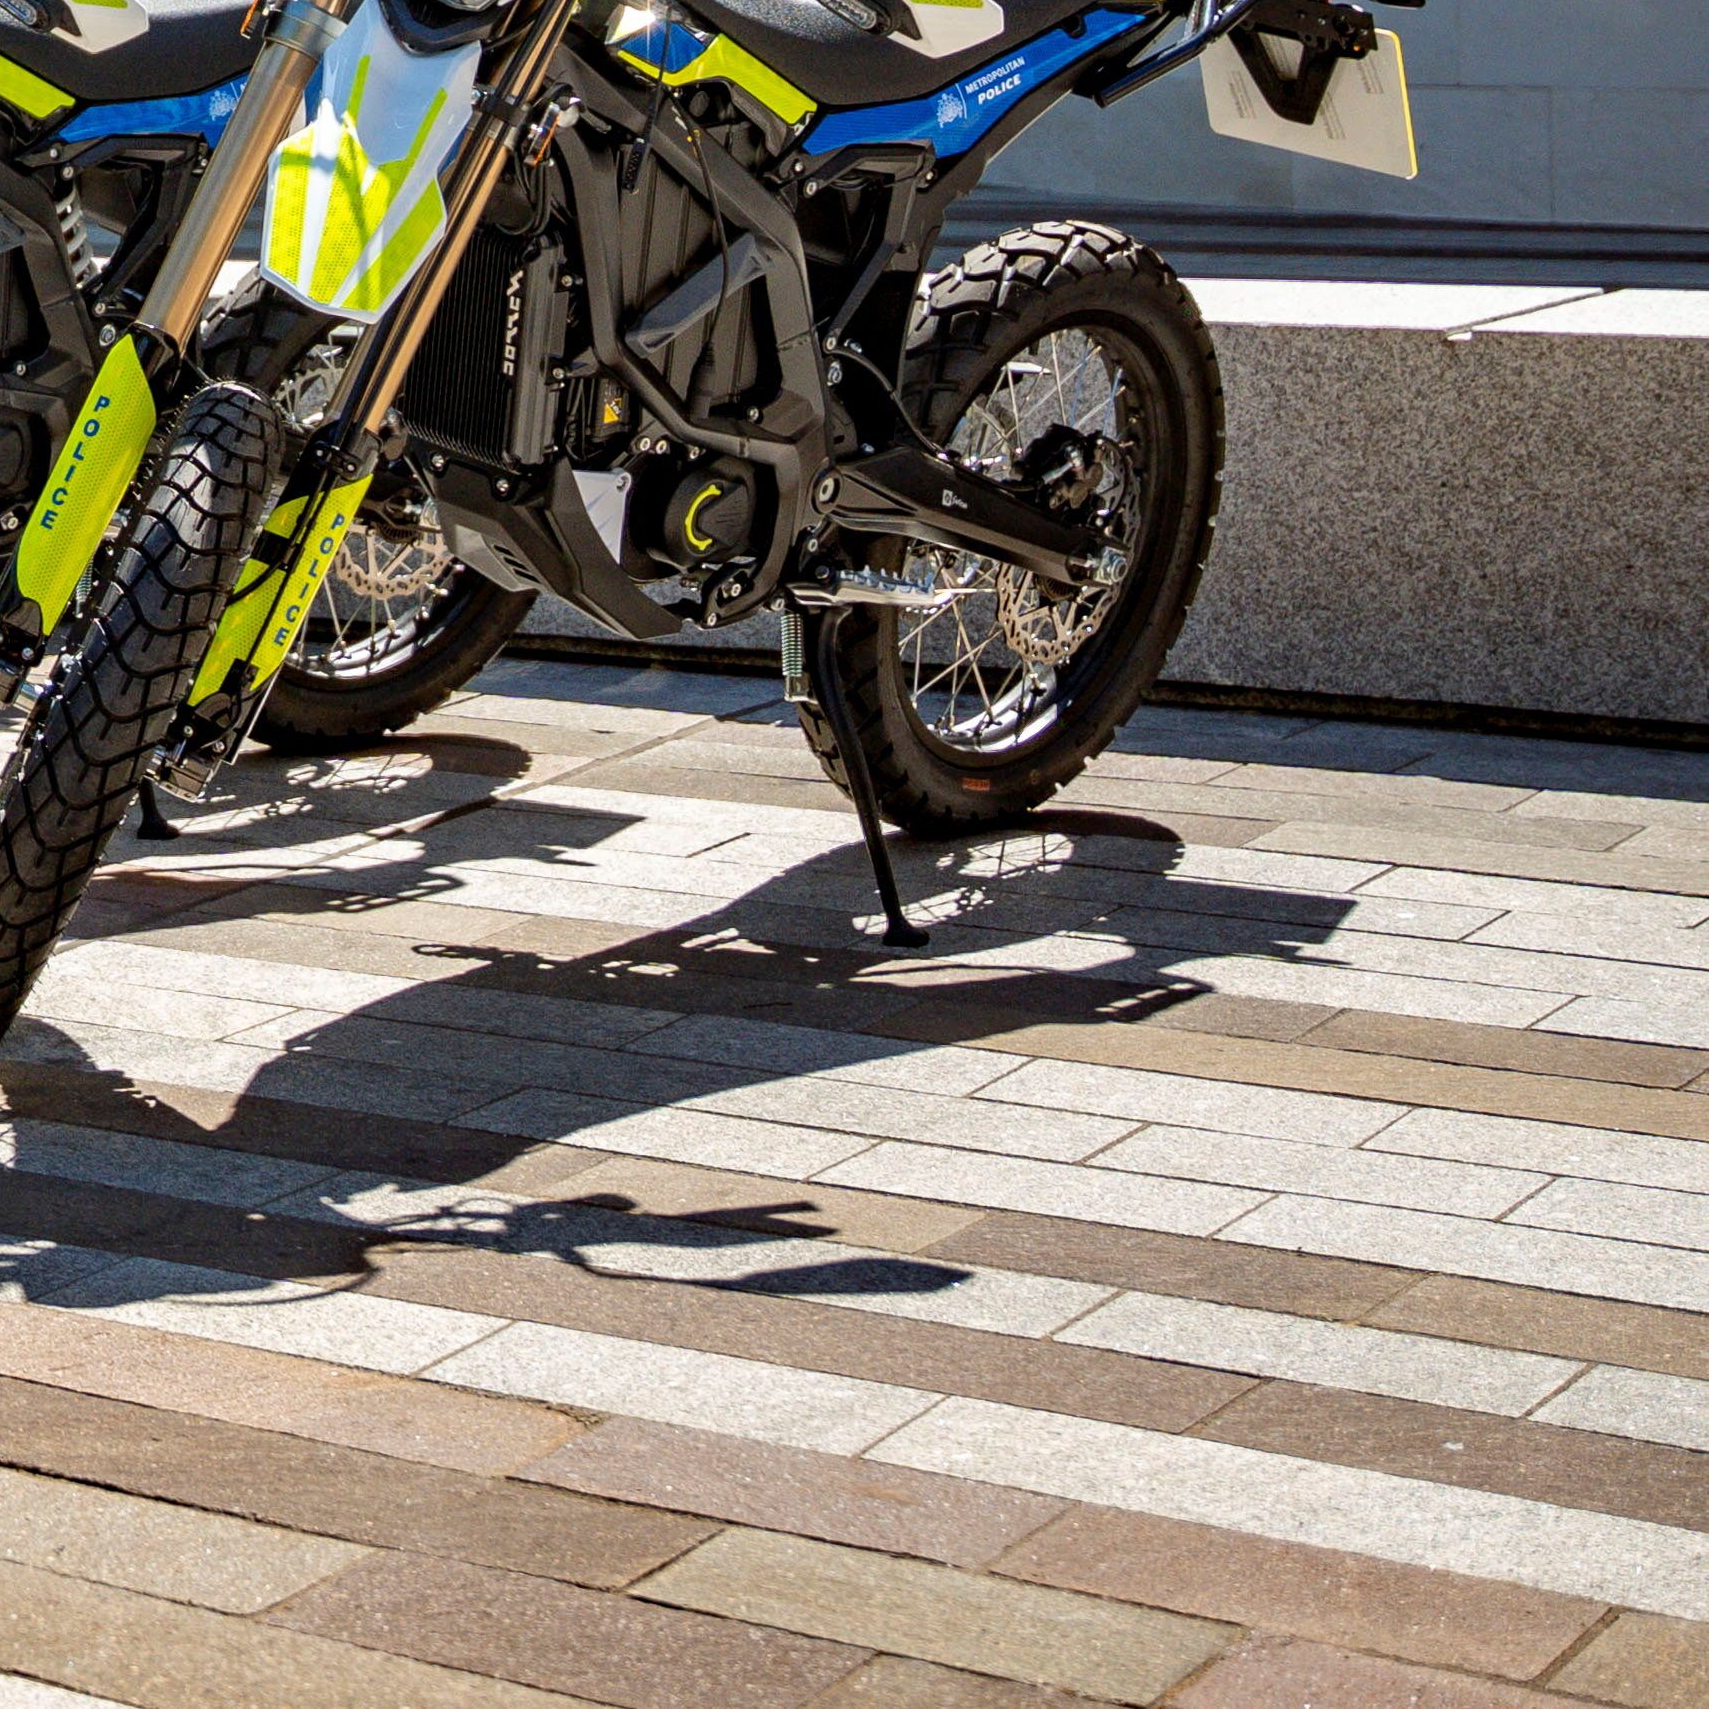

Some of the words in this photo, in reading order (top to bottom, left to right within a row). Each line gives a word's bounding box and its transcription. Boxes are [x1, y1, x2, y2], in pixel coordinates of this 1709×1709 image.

[964, 55, 1026, 94] METROPOLITAN
[977, 73, 1022, 105] POLICE
[40, 394, 111, 530] POLICE
[273, 513, 345, 647] POLICE
